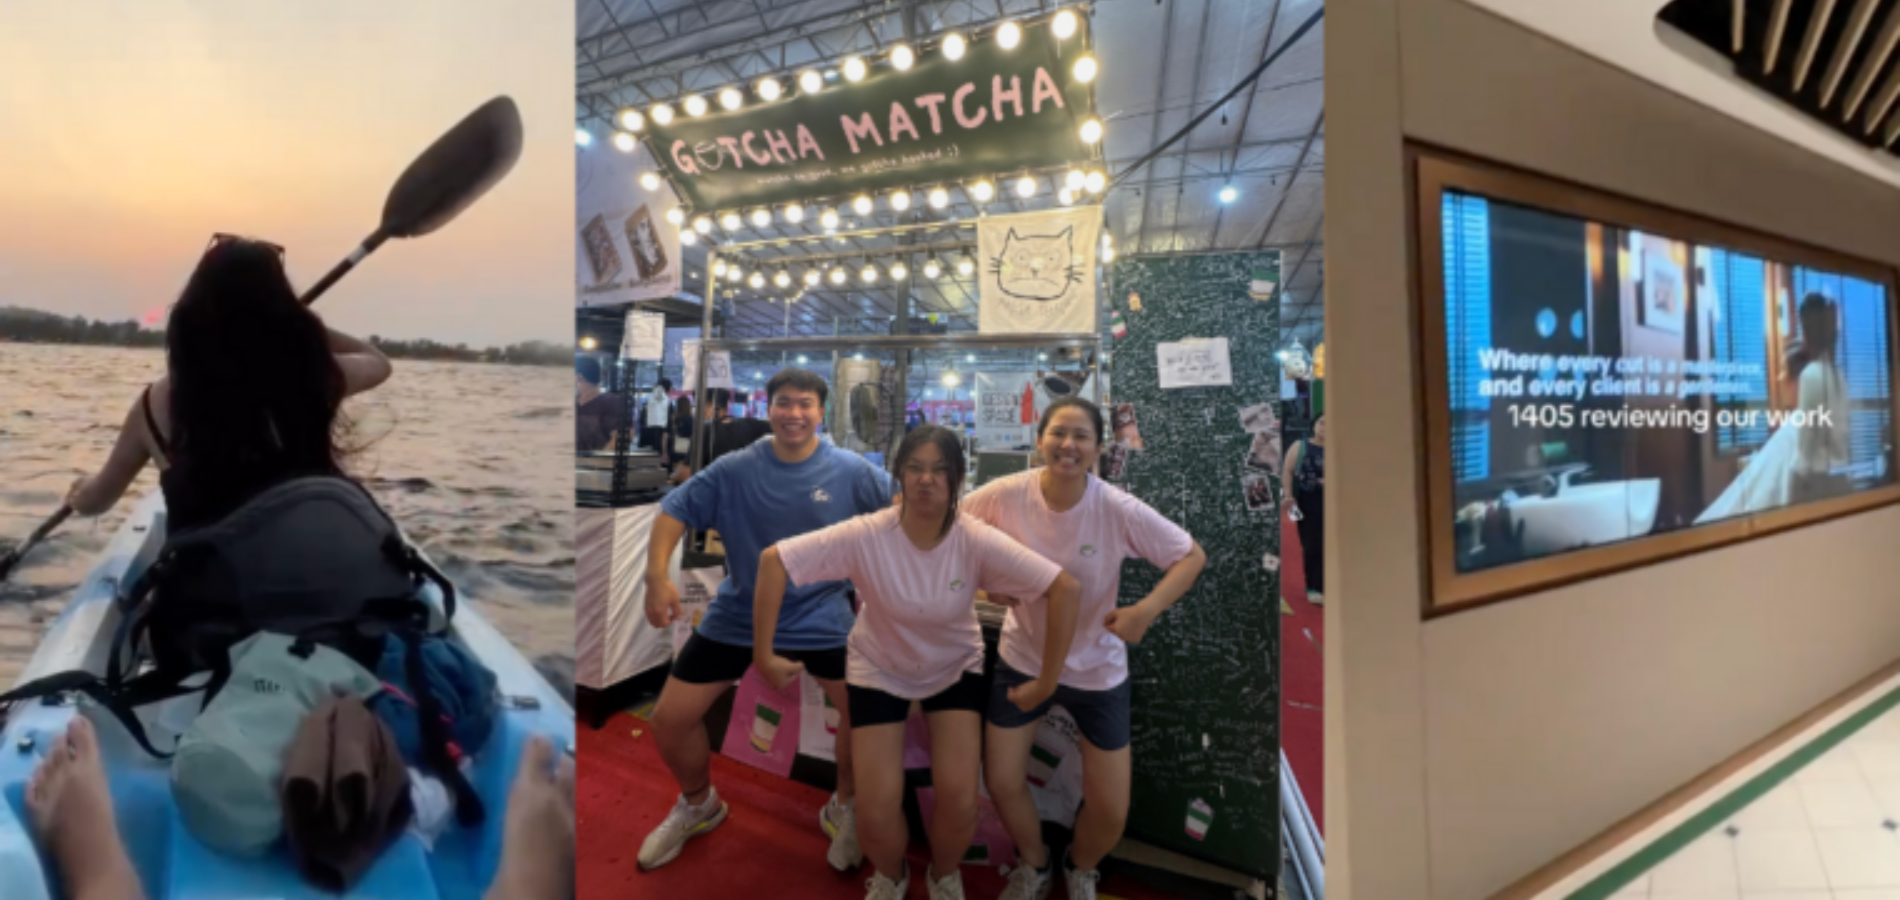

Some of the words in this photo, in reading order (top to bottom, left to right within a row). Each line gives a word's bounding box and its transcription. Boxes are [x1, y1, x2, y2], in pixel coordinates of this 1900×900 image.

[670, 124, 825, 175] GOTCHA
[840, 66, 1064, 154] MATCHA
[1478, 347, 1549, 372] Where
[1556, 354, 1611, 378] every
[1615, 356, 1643, 374] cut
[1648, 357, 1661, 374] is
[1666, 361, 1676, 375] a
[1478, 374, 1523, 396] and
[1529, 378, 1586, 399] every
[1591, 377, 1643, 396] client
[1645, 378, 1660, 395] is
[1664, 382, 1676, 395] a
